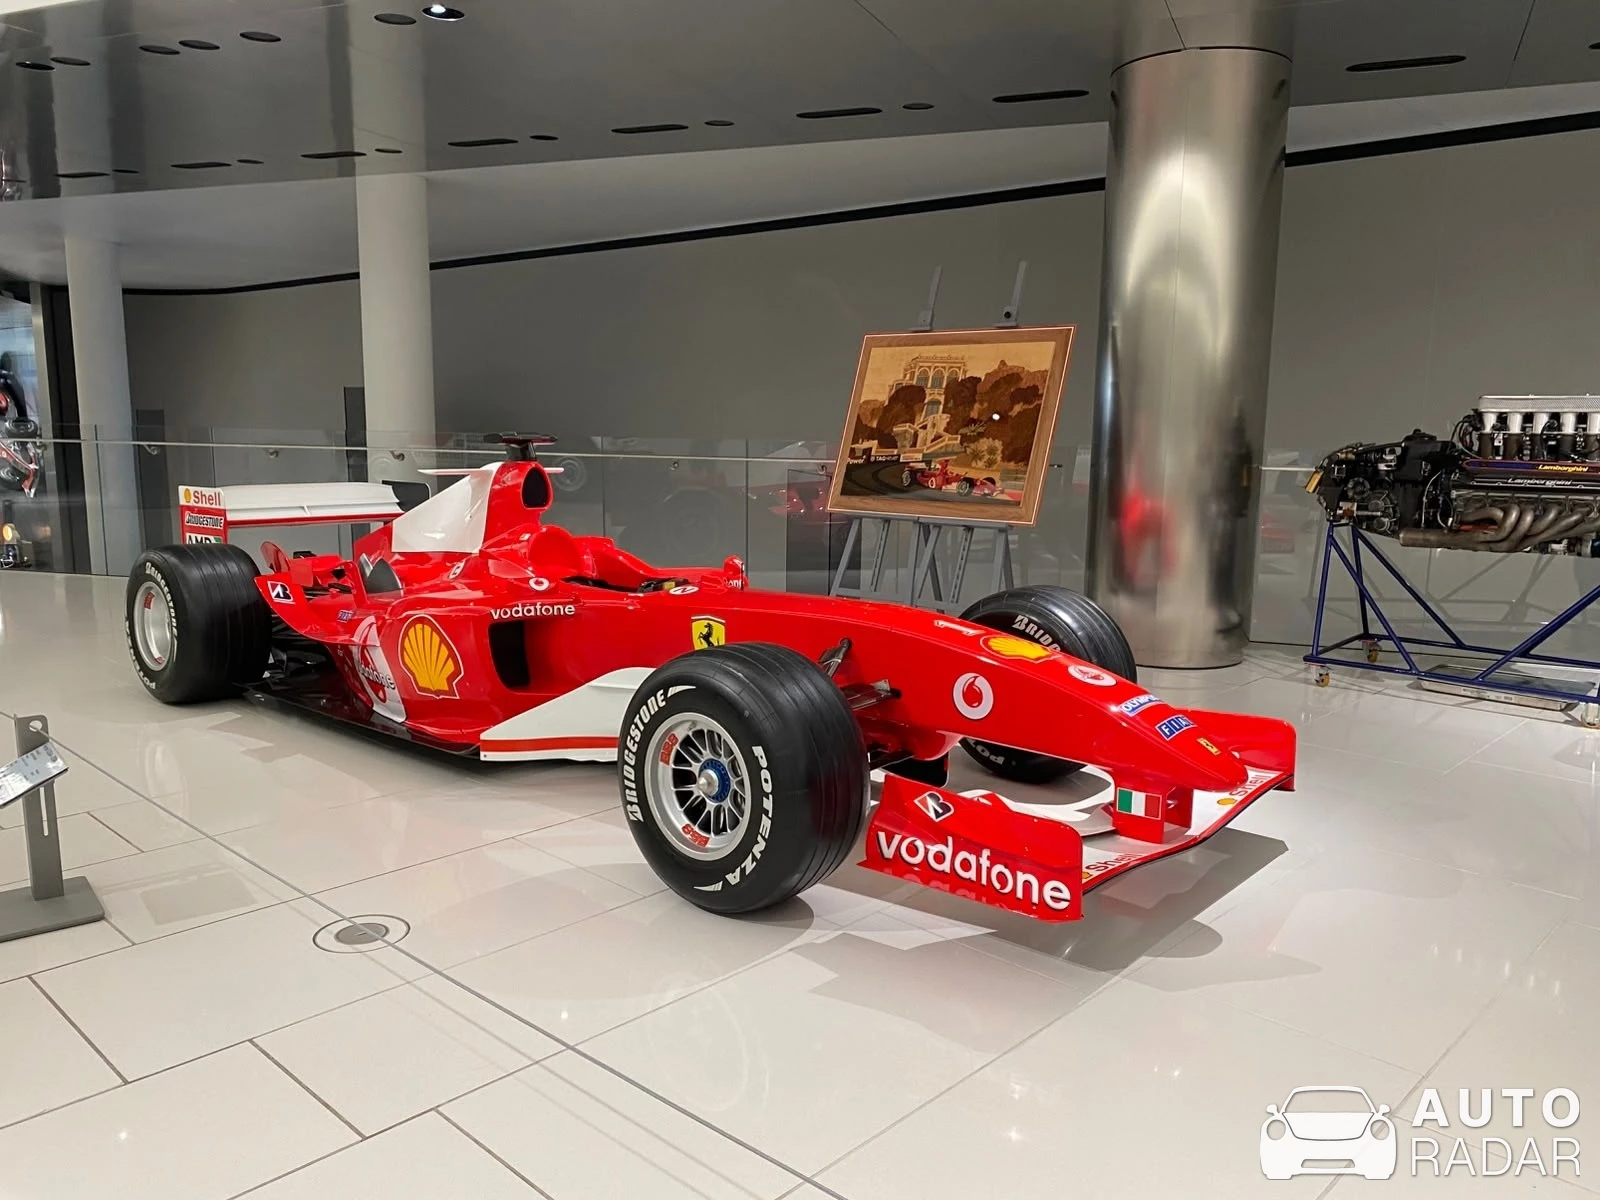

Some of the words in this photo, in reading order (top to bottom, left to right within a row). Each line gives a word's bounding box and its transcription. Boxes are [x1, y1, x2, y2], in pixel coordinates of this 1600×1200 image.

[1539, 464, 1588, 472] Lamborghini
[1508, 478, 1572, 486] Lamborghini
[193, 490, 221, 506] Shell
[186, 513, 223, 528] BRIDGESTONE
[490, 601, 575, 620] vodafone
[623, 688, 667, 823] BRIDGESTONE
[725, 746, 774, 886] POTENZA
[877, 831, 1072, 910] vodafone
[1085, 853, 1142, 872] Shell
